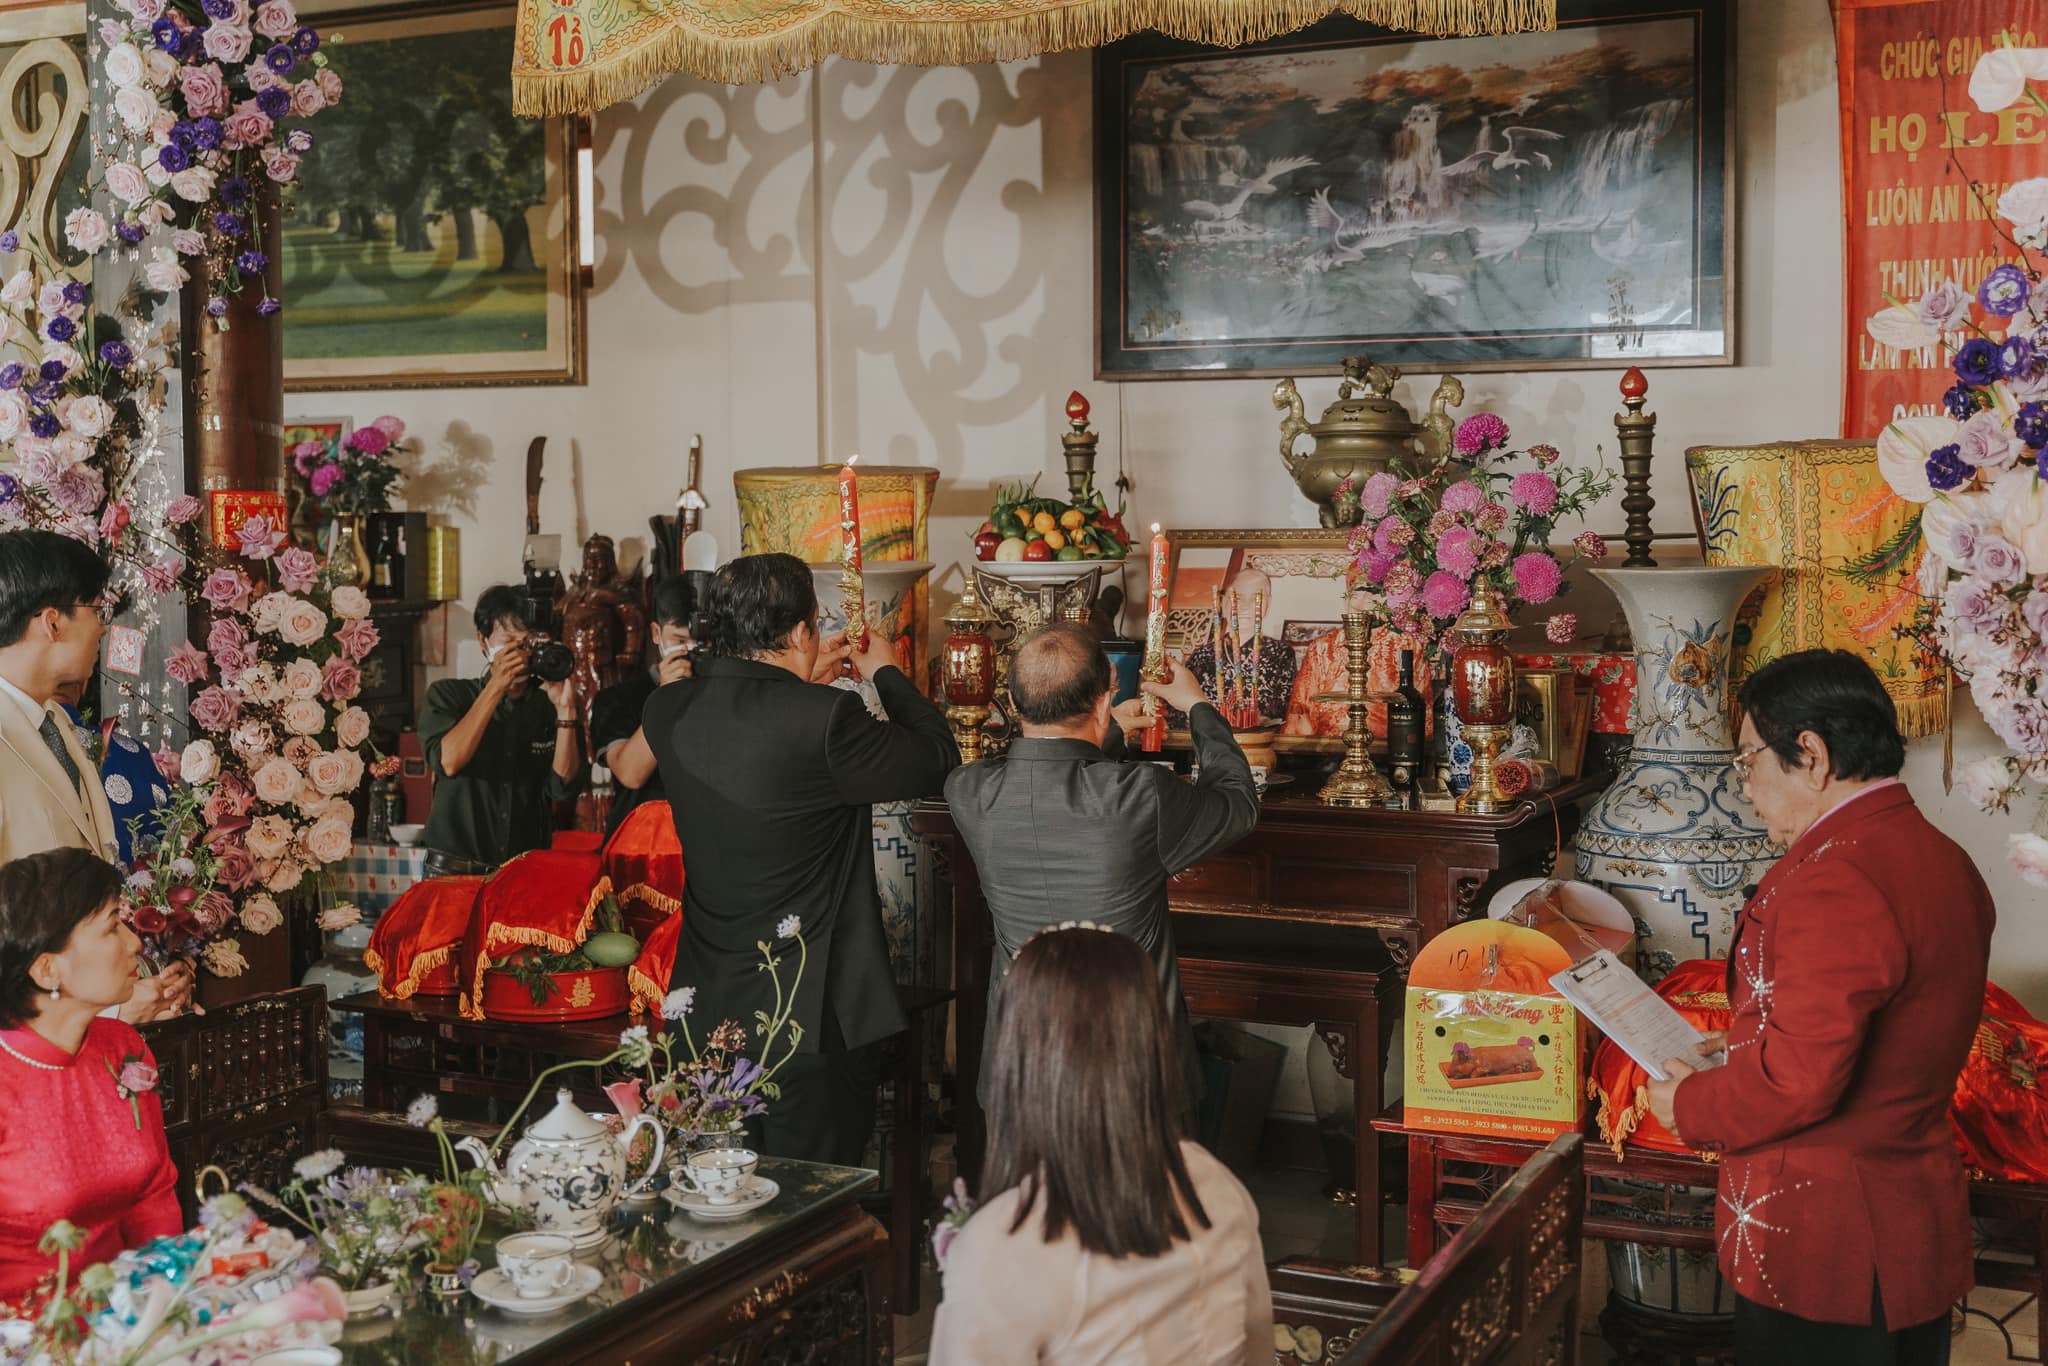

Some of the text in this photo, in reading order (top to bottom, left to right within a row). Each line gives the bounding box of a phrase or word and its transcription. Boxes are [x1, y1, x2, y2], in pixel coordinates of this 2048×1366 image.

[548, 14, 584, 66] TỔ
[1880, 31, 1940, 80] CHÚC
[1870, 96, 2047, 162] HỌ LÊ
[1866, 178, 1923, 226] LUÔN
[1929, 185, 1960, 224] AN
